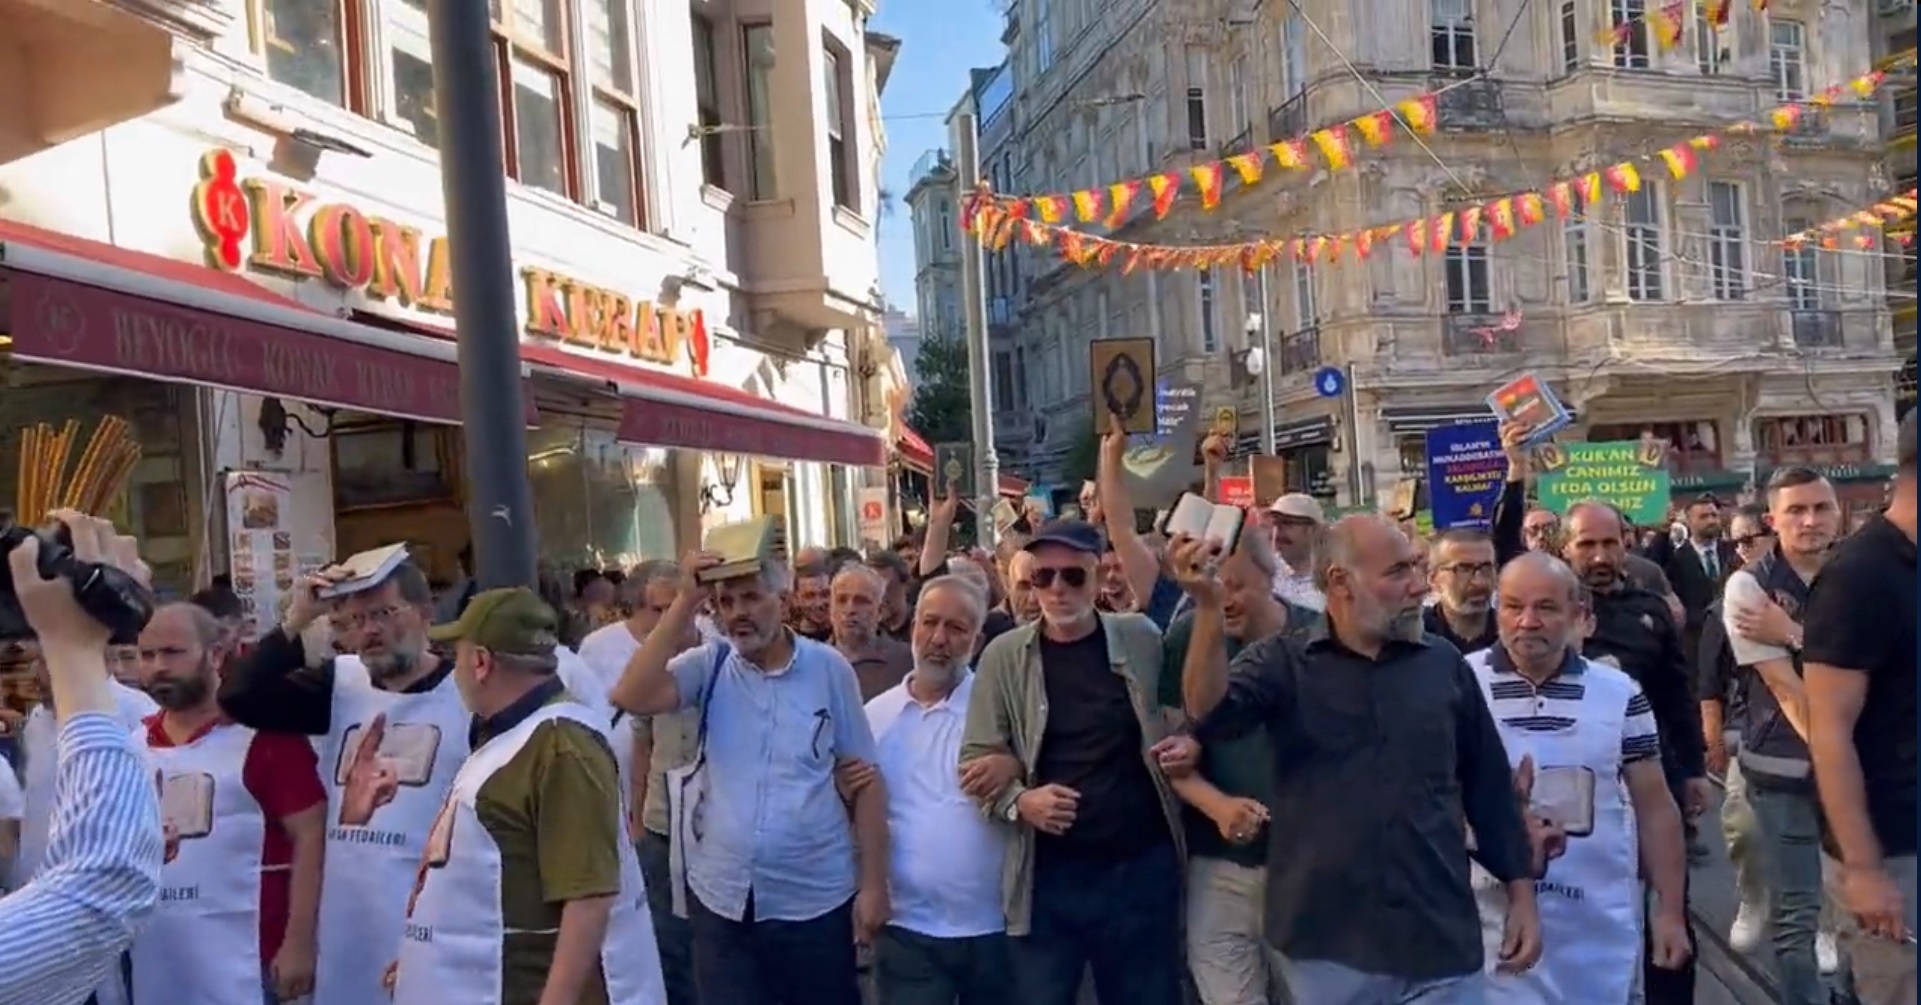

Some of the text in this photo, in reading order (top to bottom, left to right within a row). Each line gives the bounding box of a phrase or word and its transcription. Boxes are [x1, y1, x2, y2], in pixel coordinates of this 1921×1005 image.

[243, 177, 686, 366] KONA KEBAP
[1570, 450, 1635, 463] KUR'AN
[1565, 465, 1642, 479] CANIMIZ
[1552, 481, 1593, 494] FEDA
[1597, 479, 1656, 494] OLSUN
